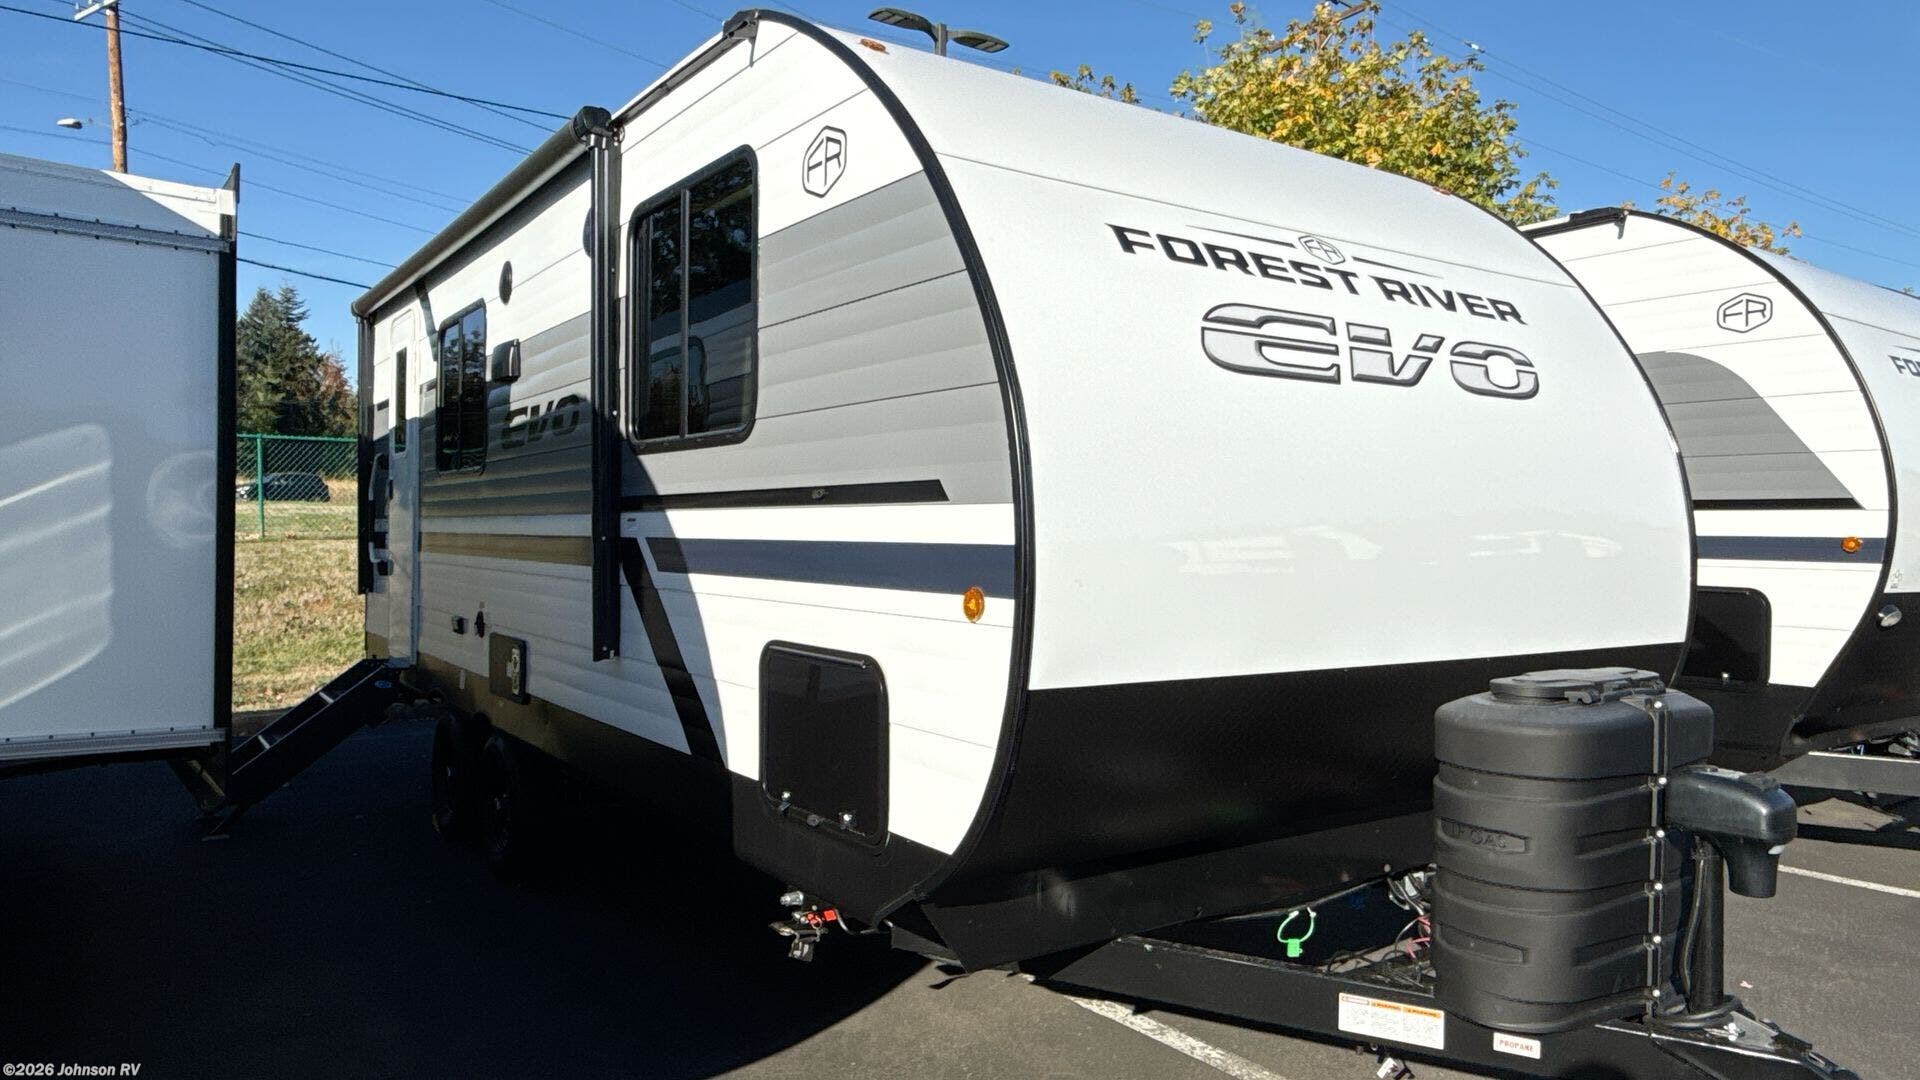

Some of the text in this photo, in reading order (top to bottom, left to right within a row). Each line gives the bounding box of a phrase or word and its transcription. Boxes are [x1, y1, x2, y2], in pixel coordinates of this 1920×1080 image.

[1105, 223, 1529, 326] FOREST RIVER
[1200, 302, 1541, 401] EVO
[501, 393, 582, 450] EVO
[1499, 1039, 1535, 1053] PROPANE
